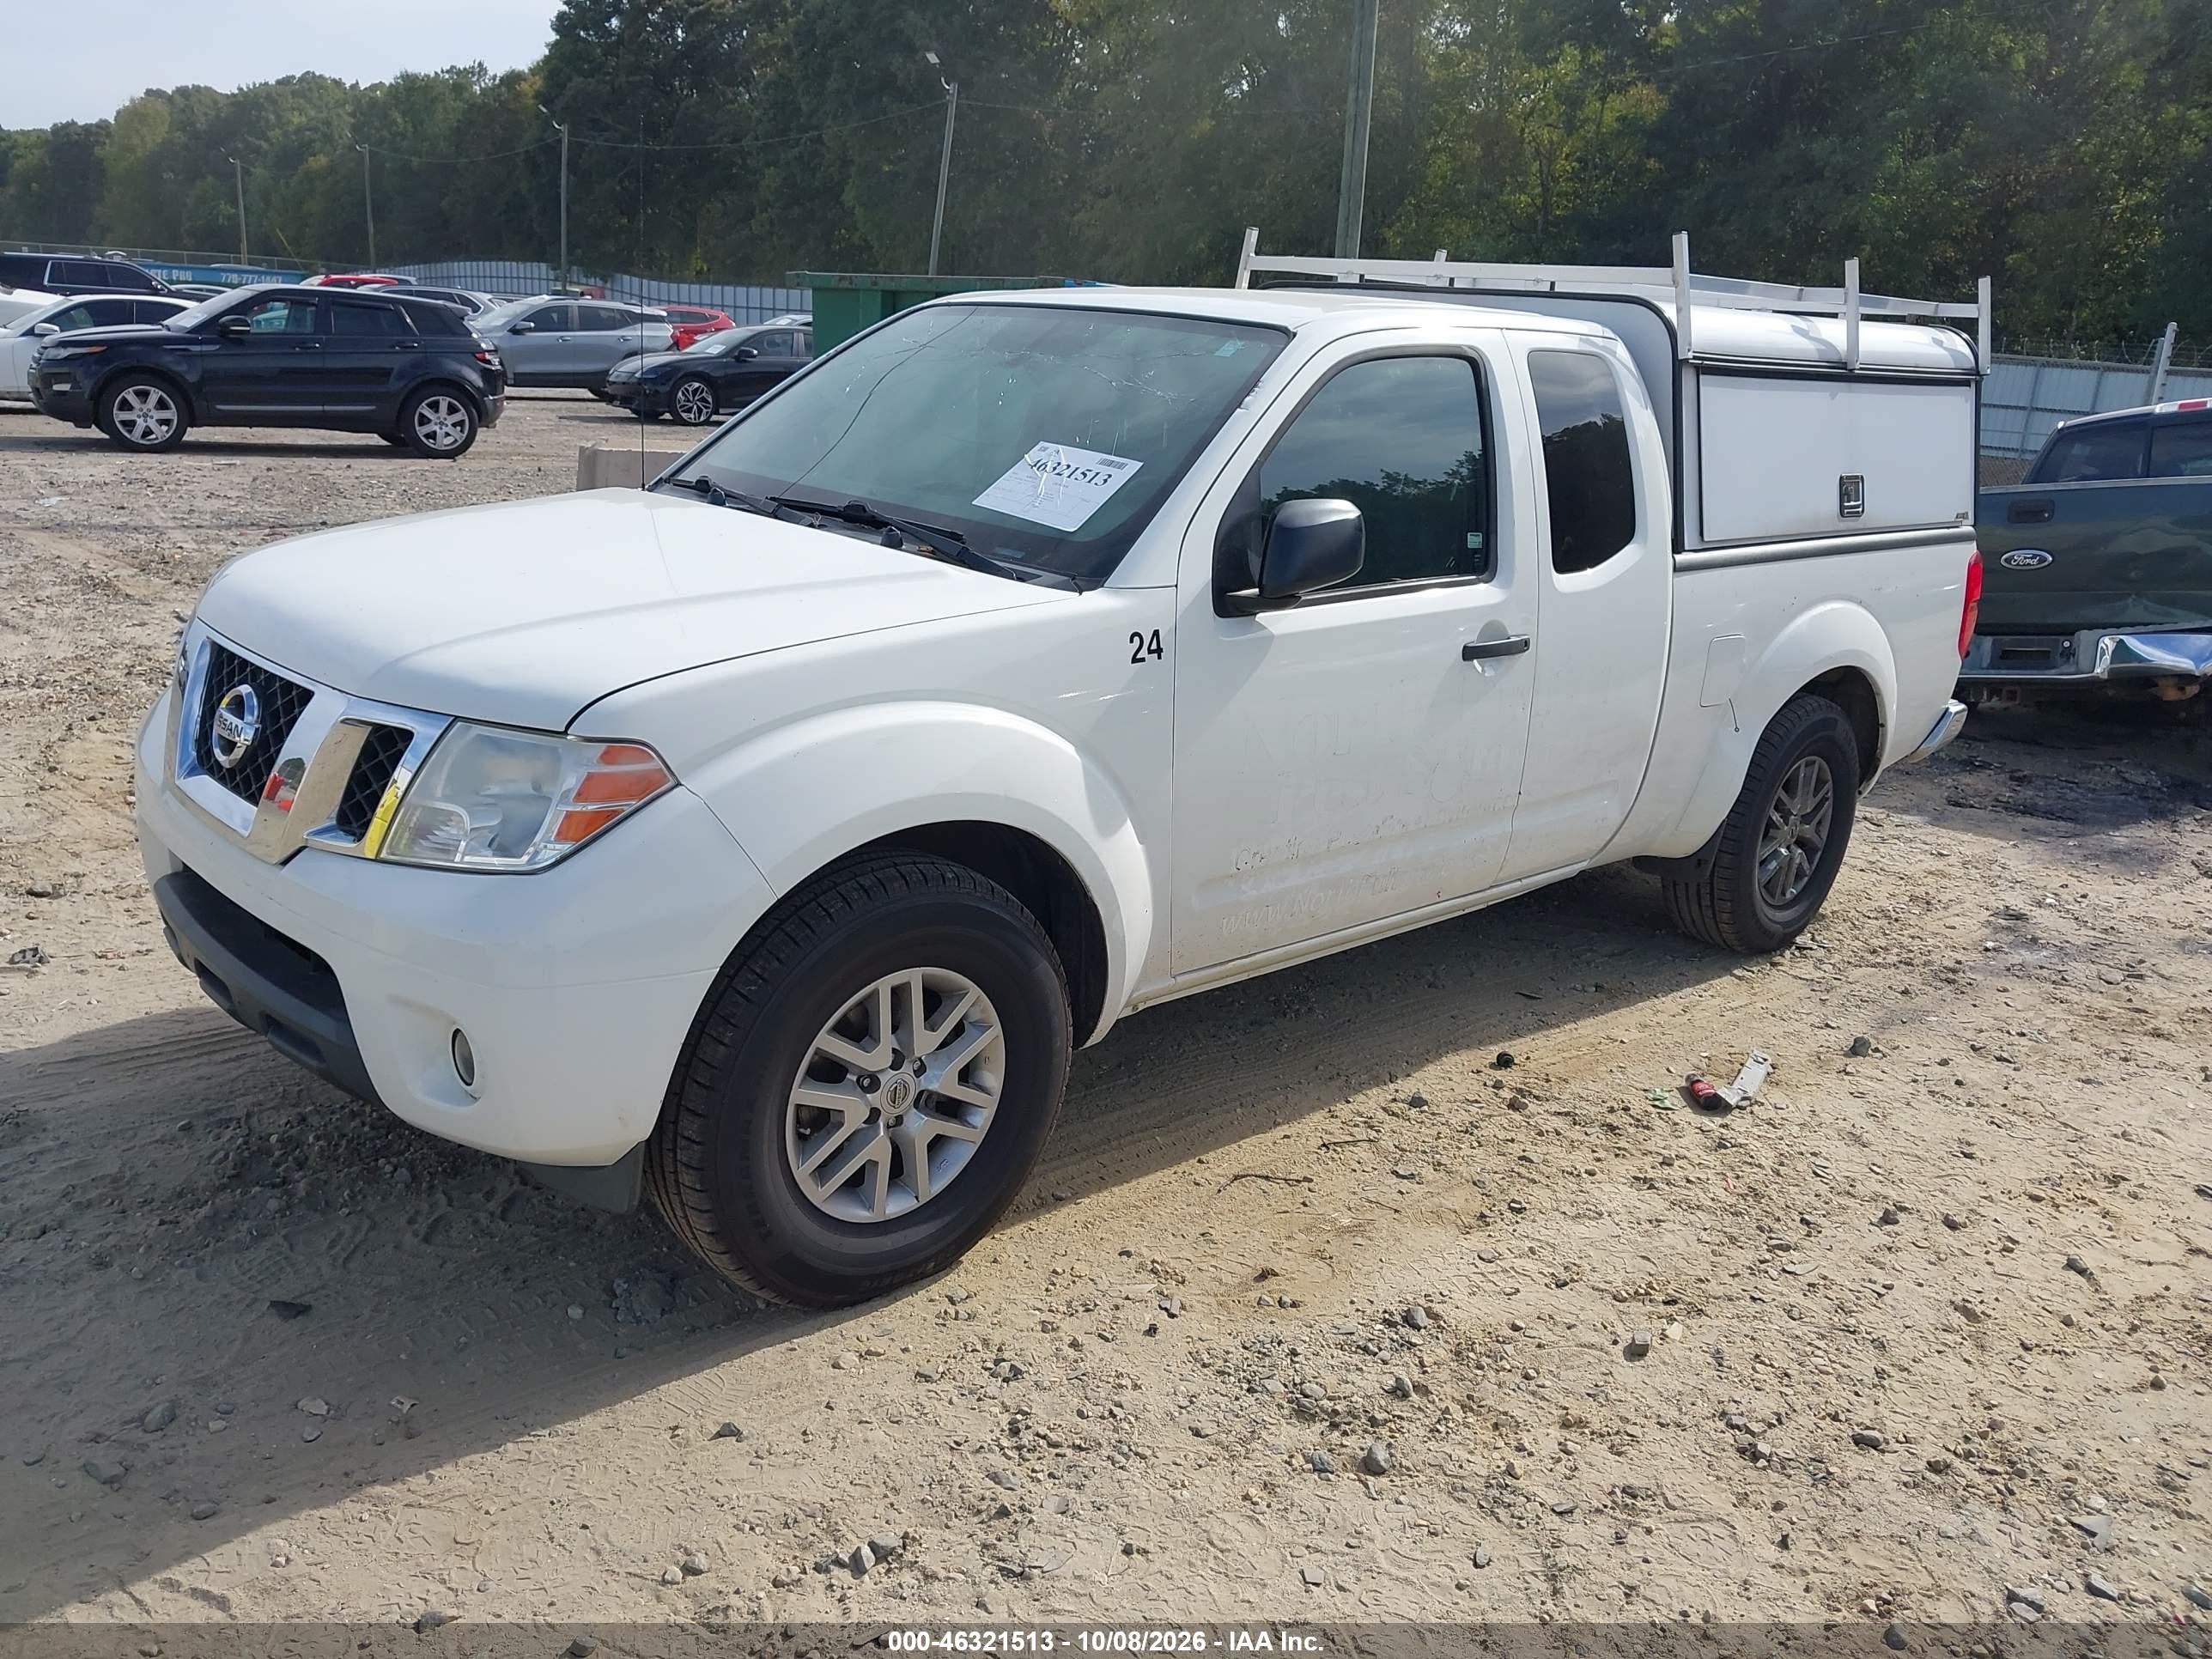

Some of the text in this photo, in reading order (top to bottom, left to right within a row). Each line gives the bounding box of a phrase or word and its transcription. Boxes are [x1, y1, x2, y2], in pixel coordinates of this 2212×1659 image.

[172, 270, 193, 282] PRO
[1029, 459, 1113, 487] 46321513
[2010, 554, 2040, 565] Ford
[1129, 629, 1164, 664] 24
